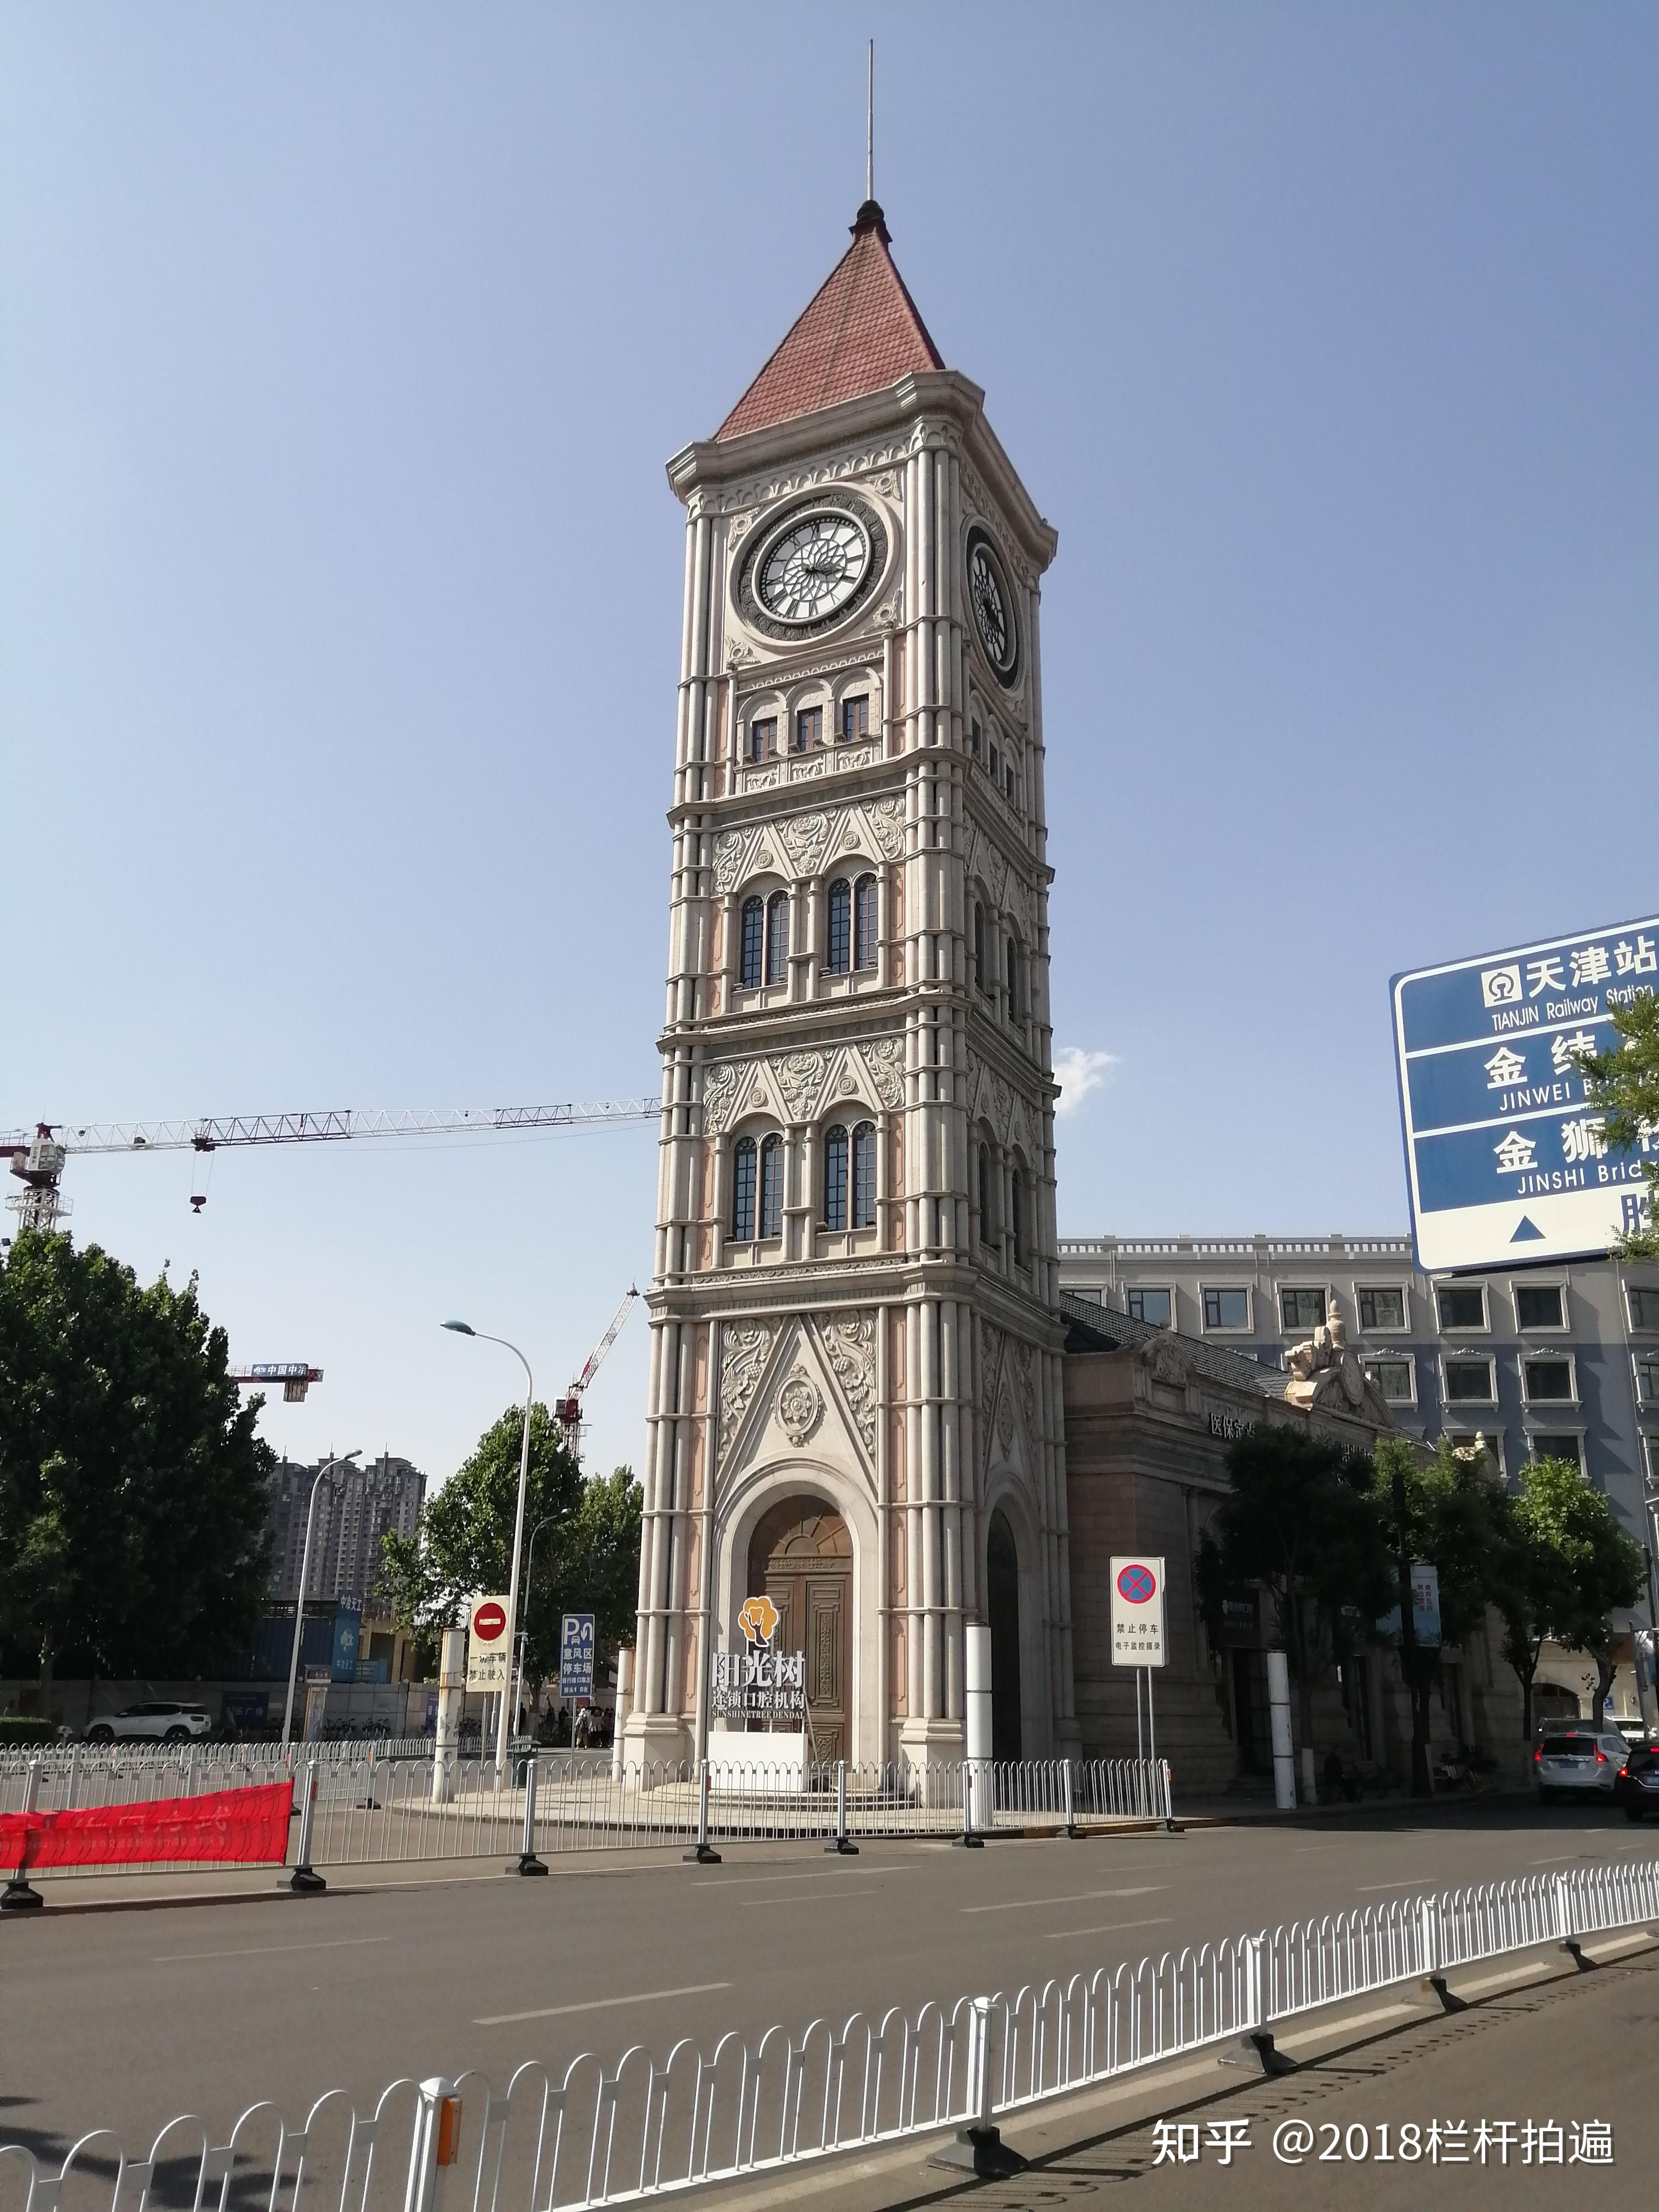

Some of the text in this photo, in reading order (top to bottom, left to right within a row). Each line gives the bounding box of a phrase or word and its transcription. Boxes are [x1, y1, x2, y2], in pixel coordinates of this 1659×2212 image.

[1526, 936, 1657, 998] 天津站
[1492, 1006, 1539, 1031] TIANJIN
[1546, 996, 1598, 1019] Railway
[1499, 1082, 1571, 1111] JINWEI
[1518, 1160, 1657, 1194] JINSHI Brid
[267, 1364, 307, 1376] 中国中冶
[340, 1594, 362, 1611] 中冶天工
[1117, 1623, 1159, 1635] 禁止停车
[1116, 1641, 1161, 1650] 电子监控摄录
[564, 1648, 592, 1660] 意风区
[469, 1669, 505, 1681] 禁止驶入
[563, 1662, 591, 1674] 停车场
[712, 1649, 806, 1688] 阳光树
[712, 1690, 806, 1710] 连锁口腔机构
[712, 1710, 805, 1719] SUNSHINETREE DENDAL
